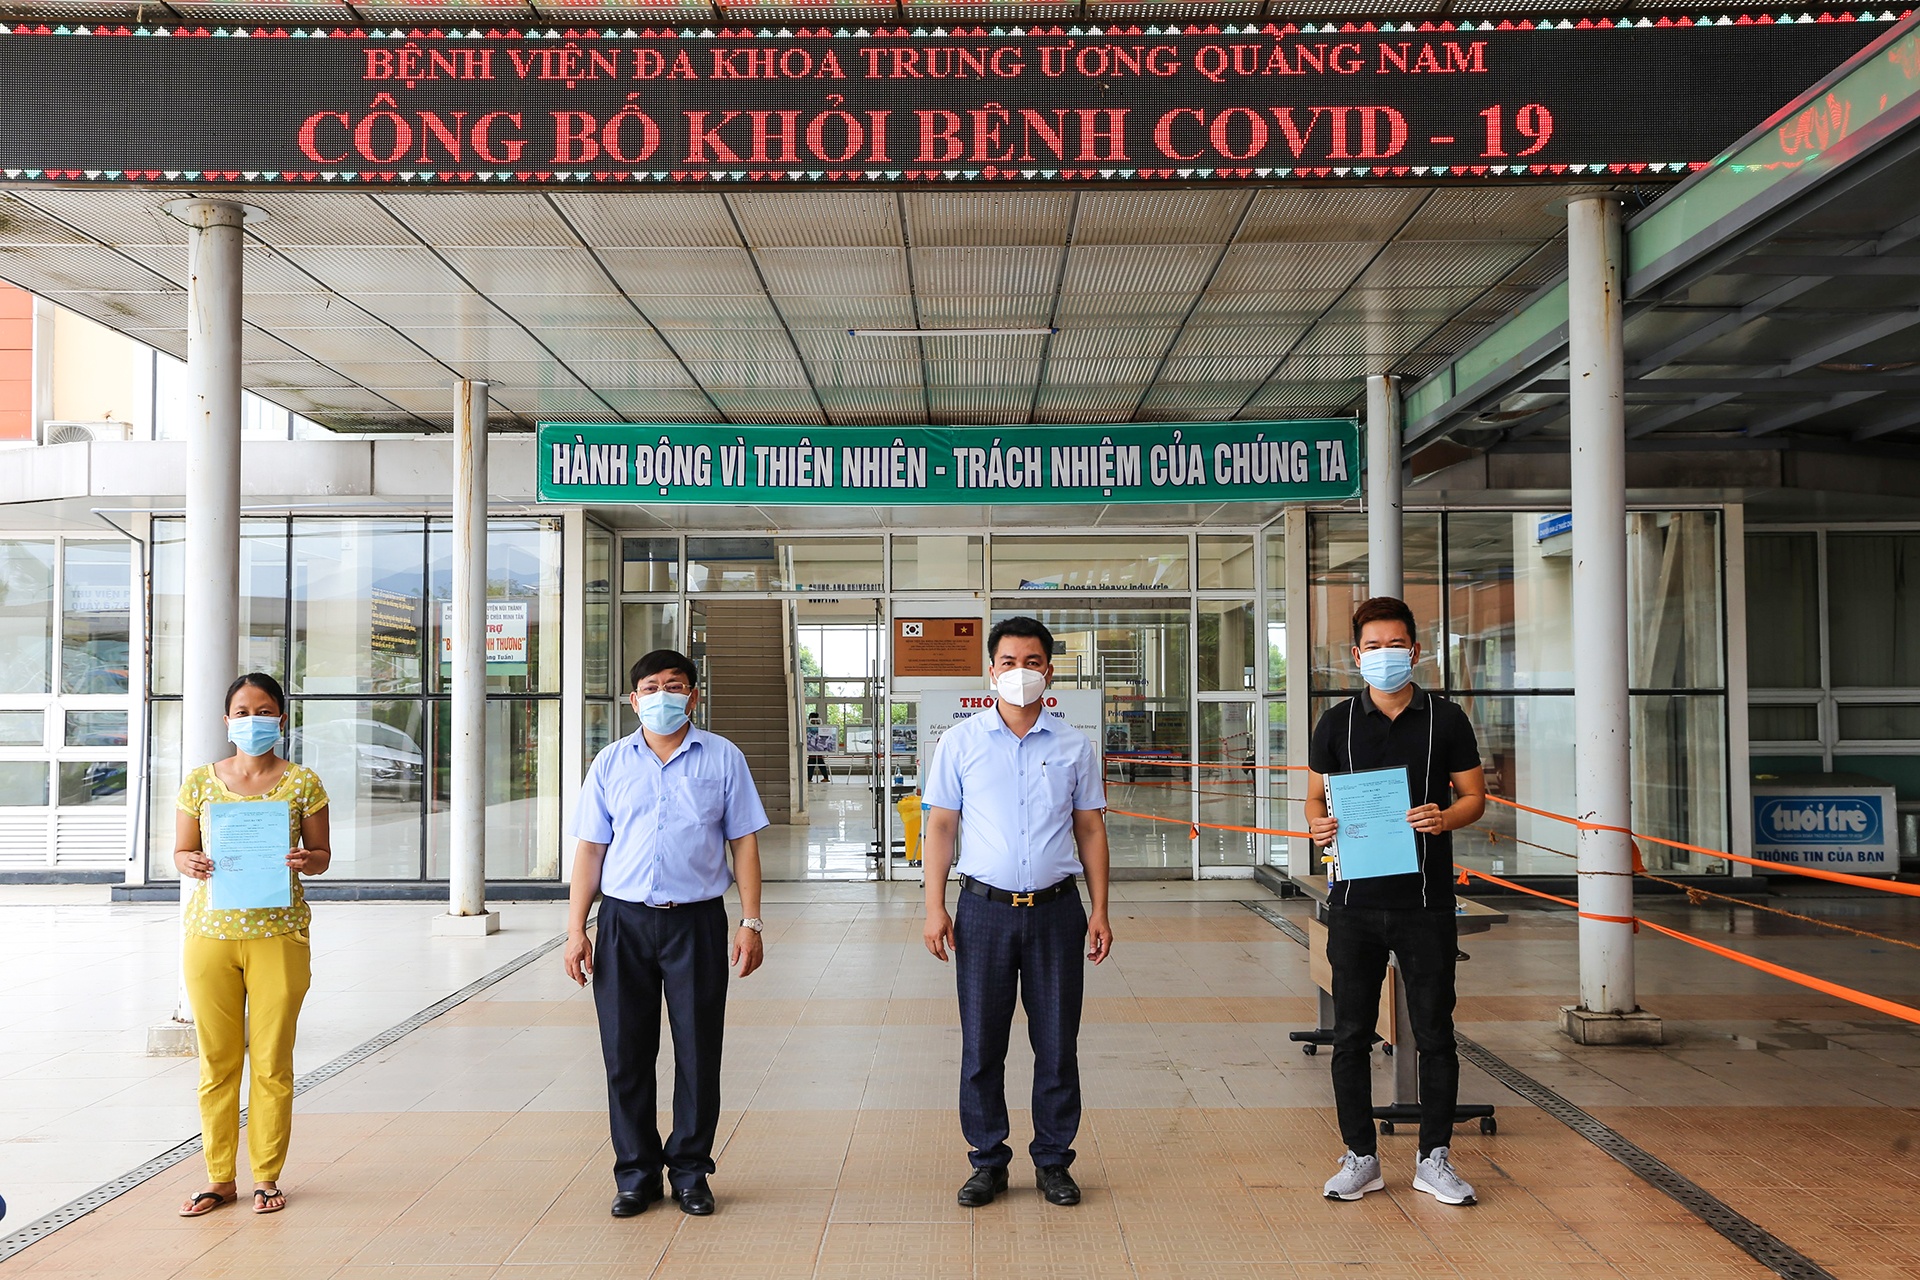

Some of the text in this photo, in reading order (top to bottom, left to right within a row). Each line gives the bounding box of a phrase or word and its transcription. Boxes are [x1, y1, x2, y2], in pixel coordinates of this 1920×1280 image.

[362, 32, 1488, 88] BỆNH VIỆN ĐA KHOA TRUNG ƯƠNG QUẢNG NAM
[298, 92, 528, 163] CÔNG
[549, 91, 661, 163] BỐ
[682, 93, 893, 163] KHỎI
[913, 102, 1130, 178] BỆNH
[1154, 105, 1409, 162] COVID
[1479, 103, 1554, 157] 19
[551, 434, 629, 486] HÀNH
[634, 435, 713, 496] ĐỘNG
[720, 436, 746, 487] VÌ
[753, 436, 834, 488] THIÊN
[841, 437, 927, 489] NHIÊN
[952, 437, 1043, 489] TRÁCH
[1050, 435, 1142, 497] NHIỆM
[1149, 429, 1207, 487] CỦA
[1213, 433, 1309, 486] CHÚNG
[1315, 439, 1349, 483] TA
[847, 583, 884, 592] UNIVERSIT
[960, 694, 998, 708] THÔ
[1757, 846, 1885, 865] THÔNG TIN CỦA BẠN
